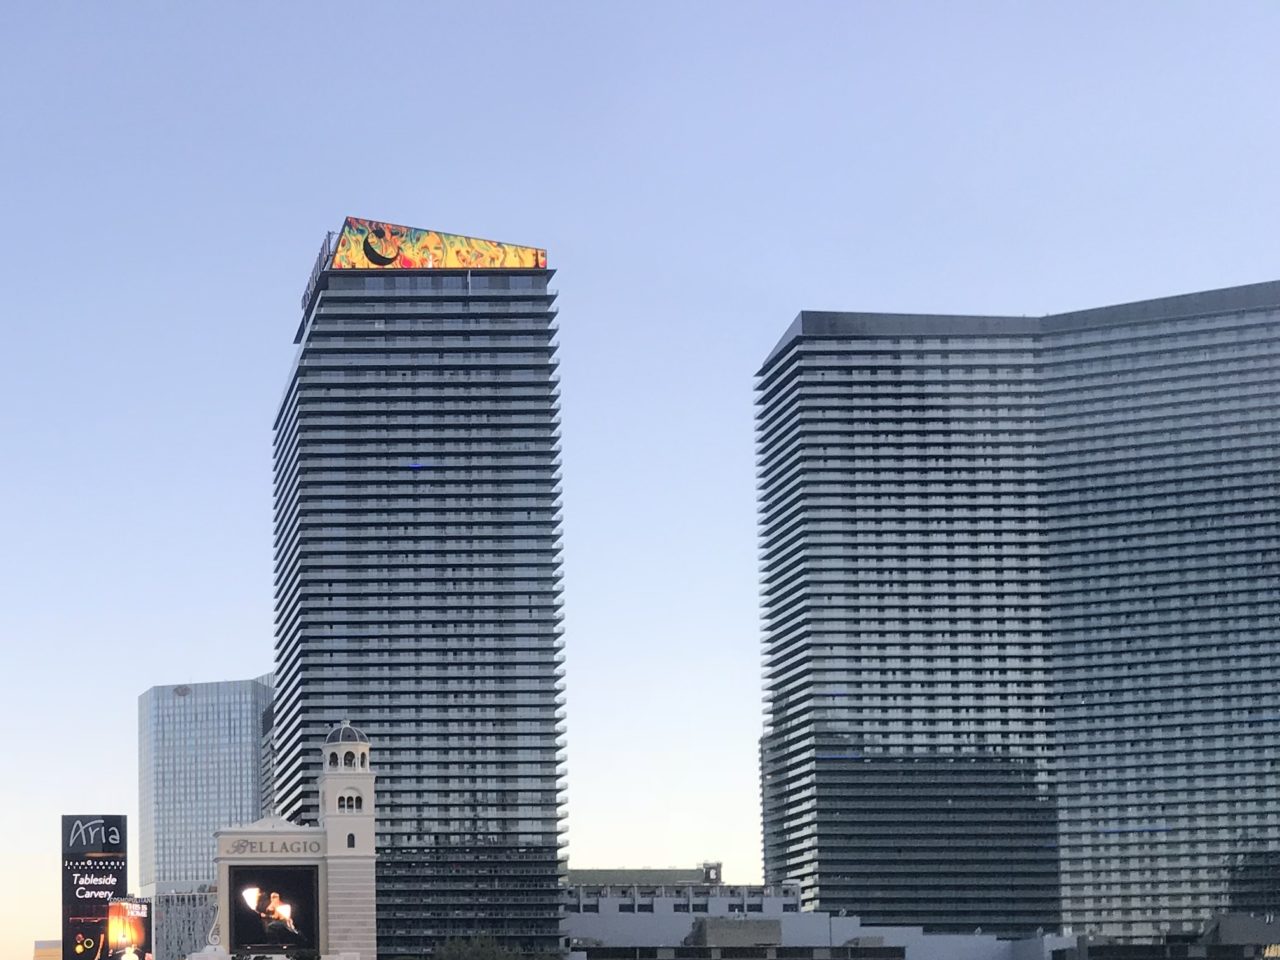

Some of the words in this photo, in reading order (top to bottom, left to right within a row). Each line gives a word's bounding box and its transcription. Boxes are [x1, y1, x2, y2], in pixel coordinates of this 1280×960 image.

[69, 819, 121, 847] Aria
[226, 839, 321, 854] BELLAGIO
[72, 873, 118, 886] Tableside
[75, 887, 114, 901] Carvery
